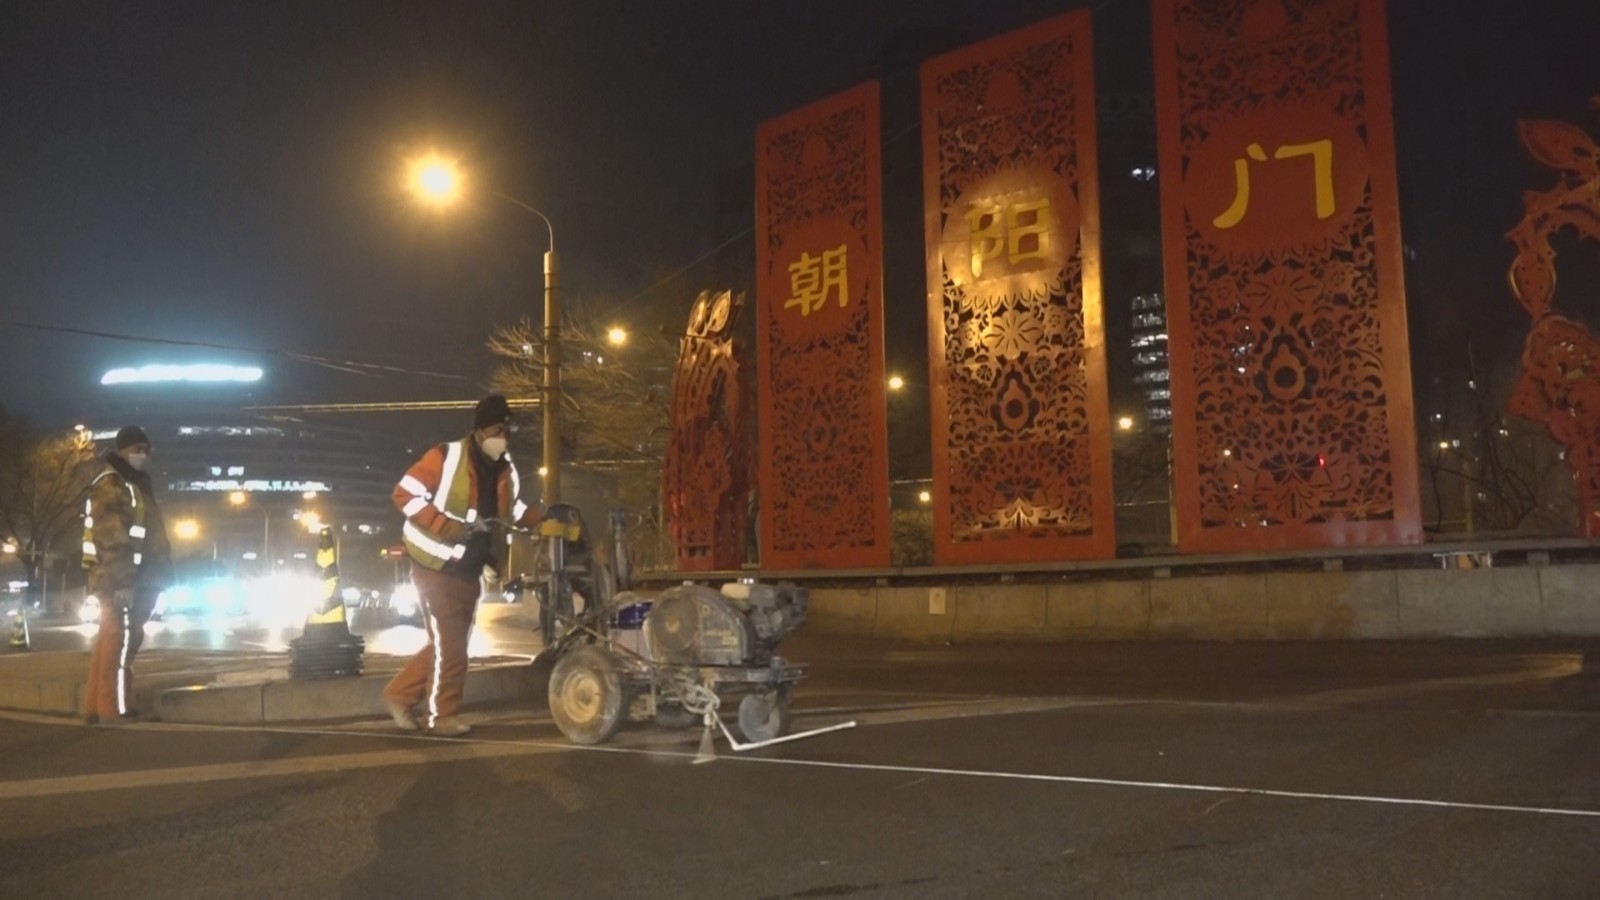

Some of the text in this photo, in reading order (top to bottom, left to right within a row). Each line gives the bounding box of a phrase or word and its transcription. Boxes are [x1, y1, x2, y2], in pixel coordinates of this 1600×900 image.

[1213, 139, 1335, 229] 门
[966, 198, 1051, 279] 阳
[784, 244, 849, 316] 朝
